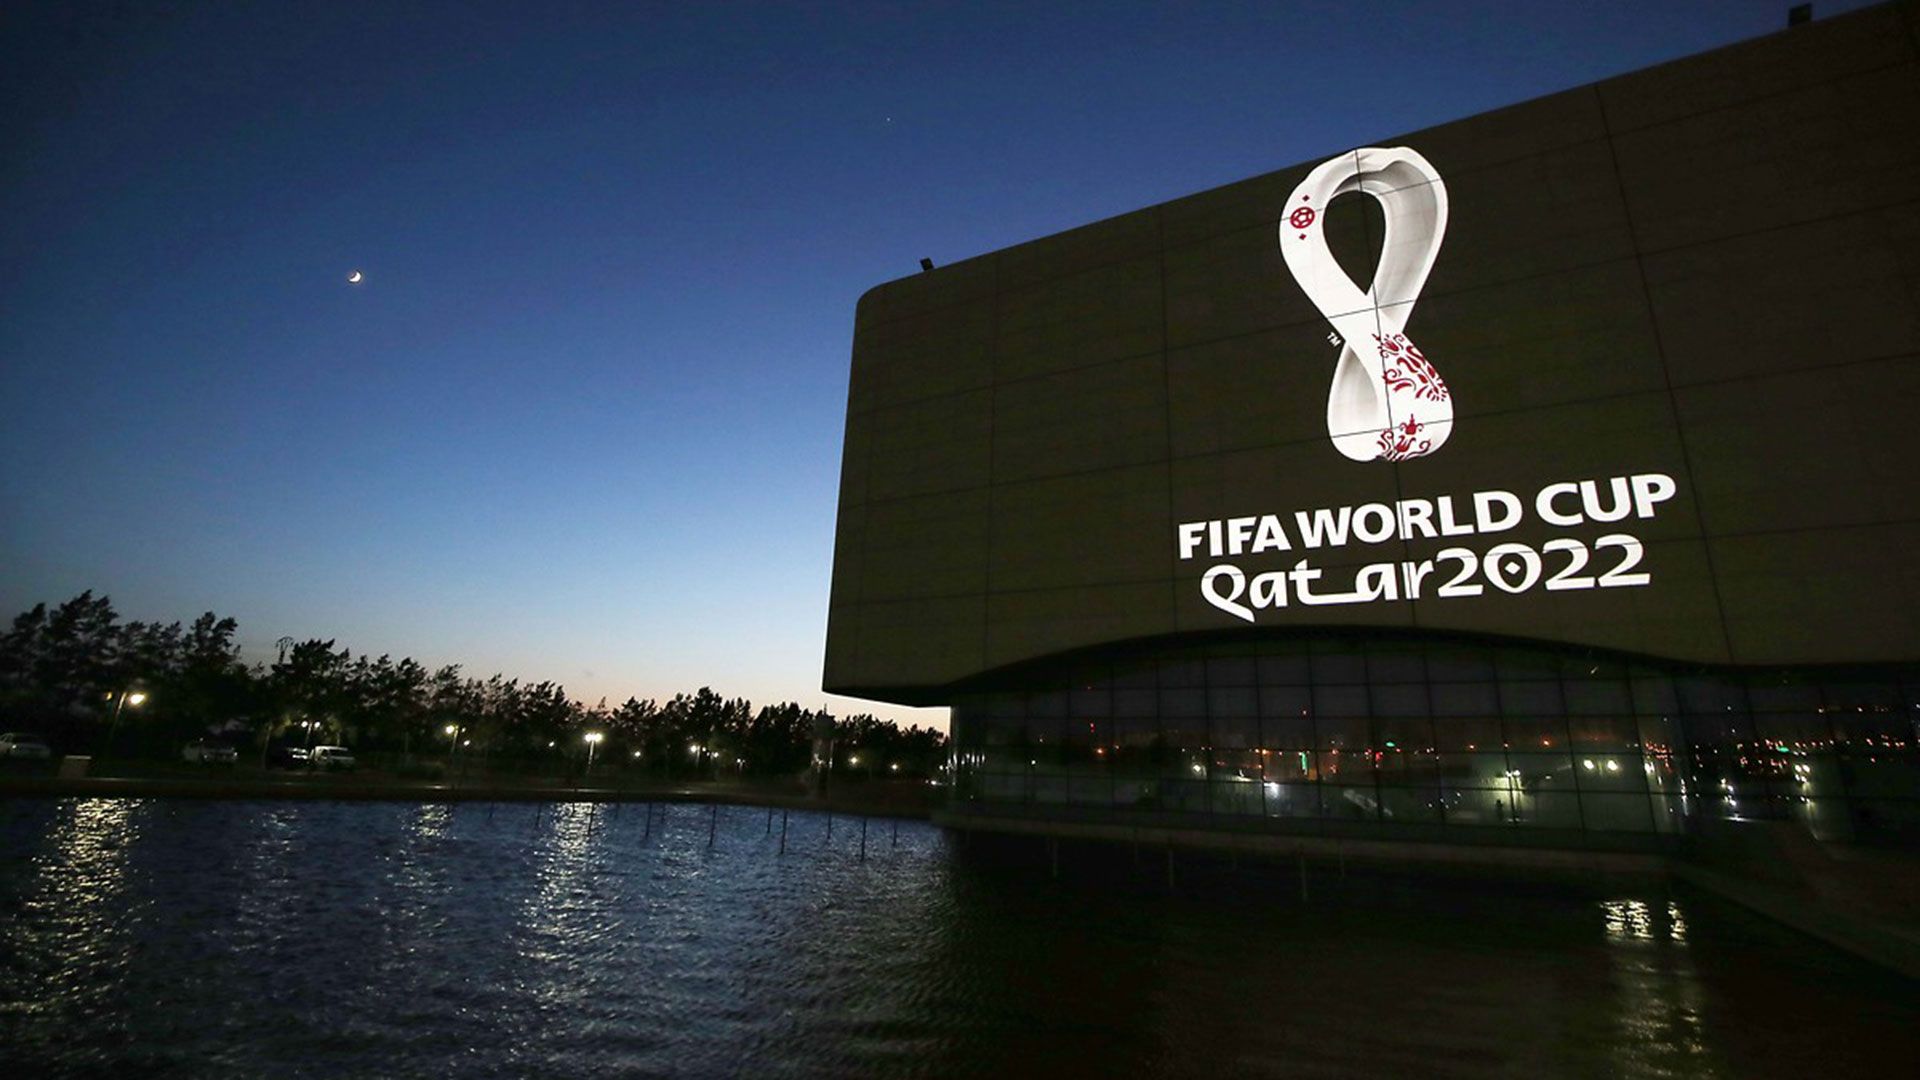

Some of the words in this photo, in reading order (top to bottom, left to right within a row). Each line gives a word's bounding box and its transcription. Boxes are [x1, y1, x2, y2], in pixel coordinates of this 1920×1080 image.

[1178, 514, 1292, 560] FIFA
[1294, 490, 1523, 549] WORLD
[1535, 473, 1677, 527] CUP
